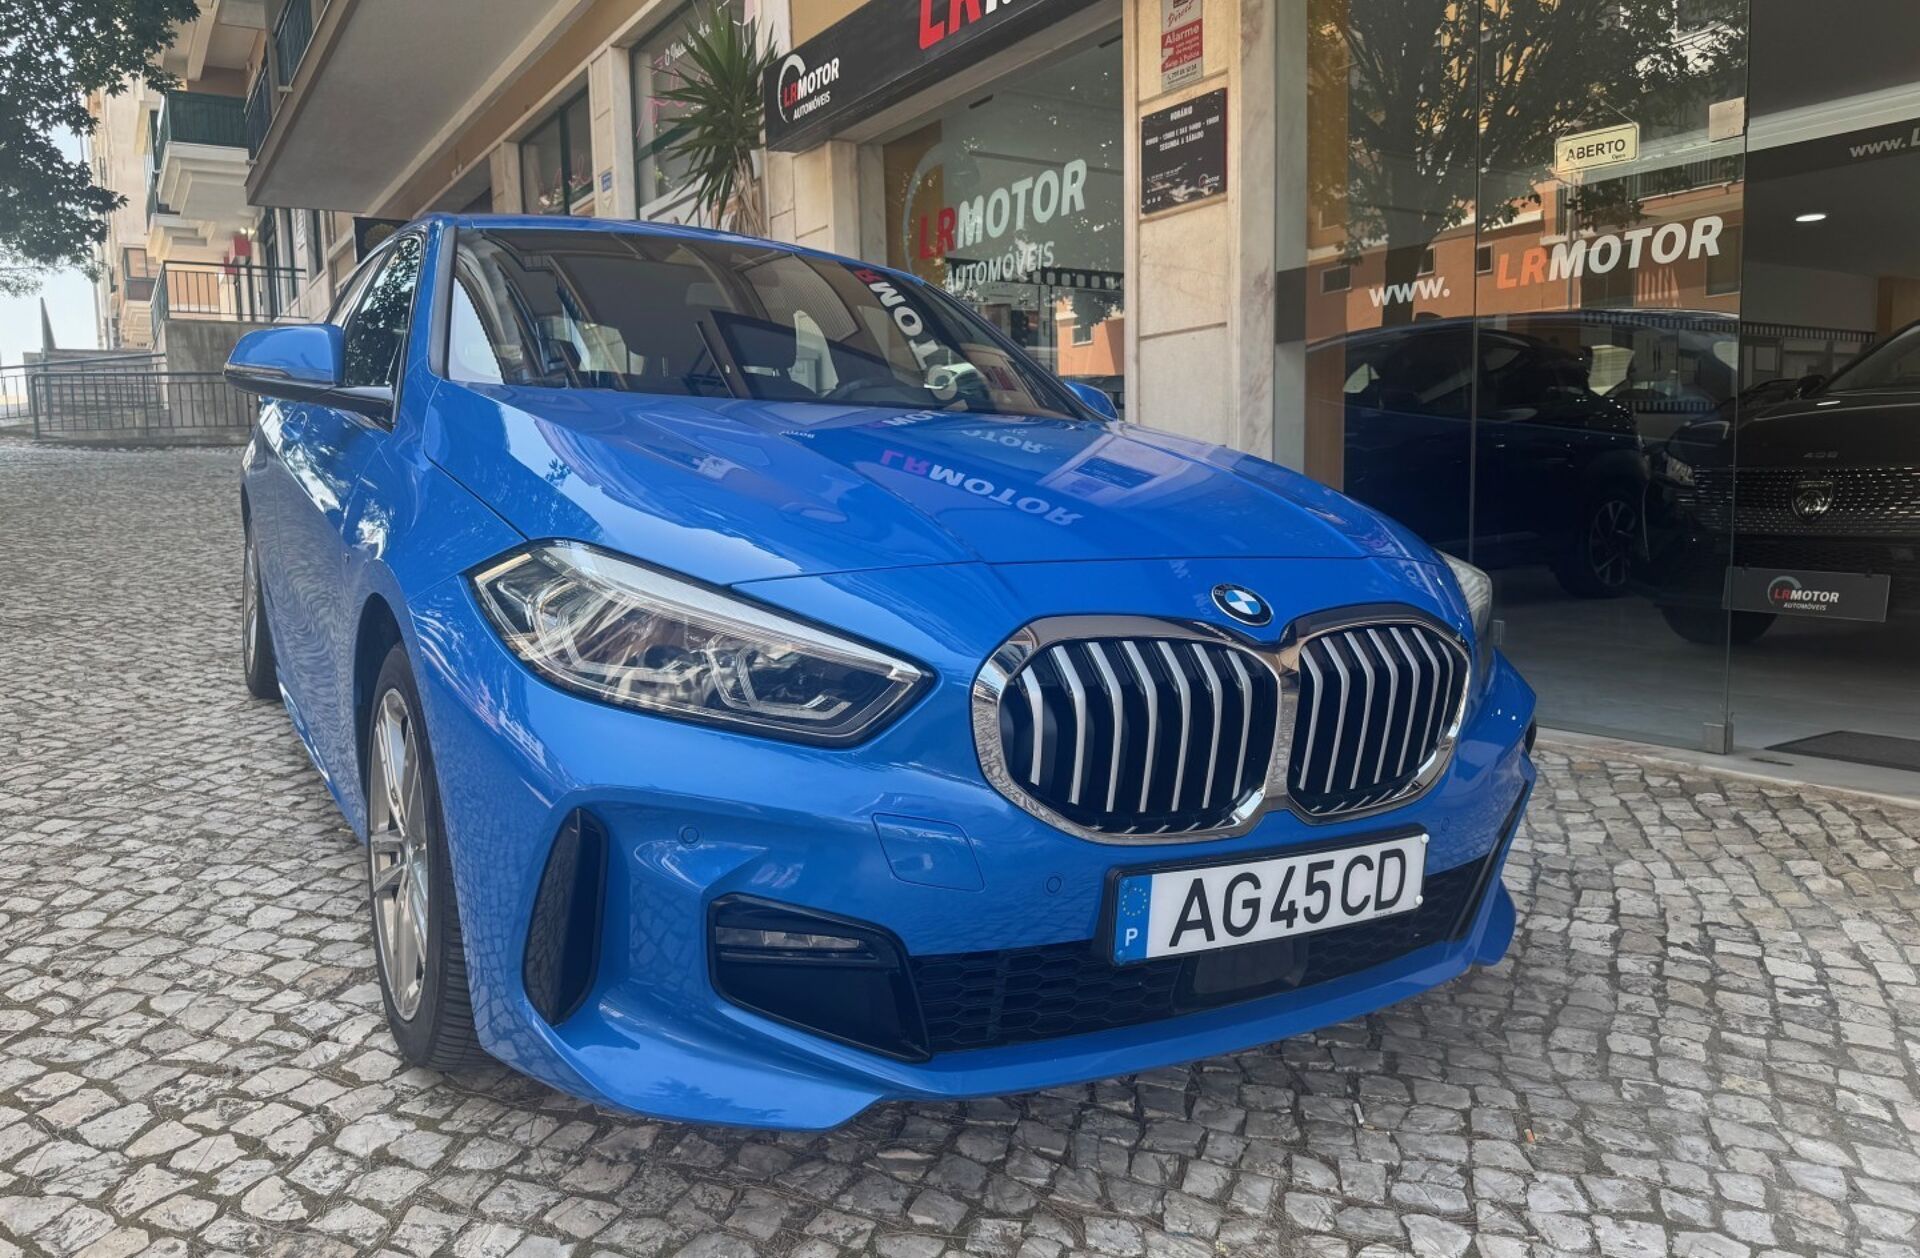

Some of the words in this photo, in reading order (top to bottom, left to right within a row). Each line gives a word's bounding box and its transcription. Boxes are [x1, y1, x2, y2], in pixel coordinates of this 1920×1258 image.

[1165, 25, 1200, 47] Alarme
[783, 57, 840, 108] LRMOTOR
[793, 90, 830, 120] AUTOMÓVEIS
[1566, 139, 1626, 162] ABERTO
[1849, 137, 1906, 158] www.
[918, 159, 1087, 261] LRMOTOR
[945, 241, 1055, 294] AUTOMÓVEIS
[1369, 276, 1450, 308] www.
[1496, 215, 1724, 290] LRMOTOR
[1774, 588, 1840, 603] LRMOTOR
[1783, 602, 1827, 611] AUTOMÓVEIS
[1124, 928, 1138, 947] P
